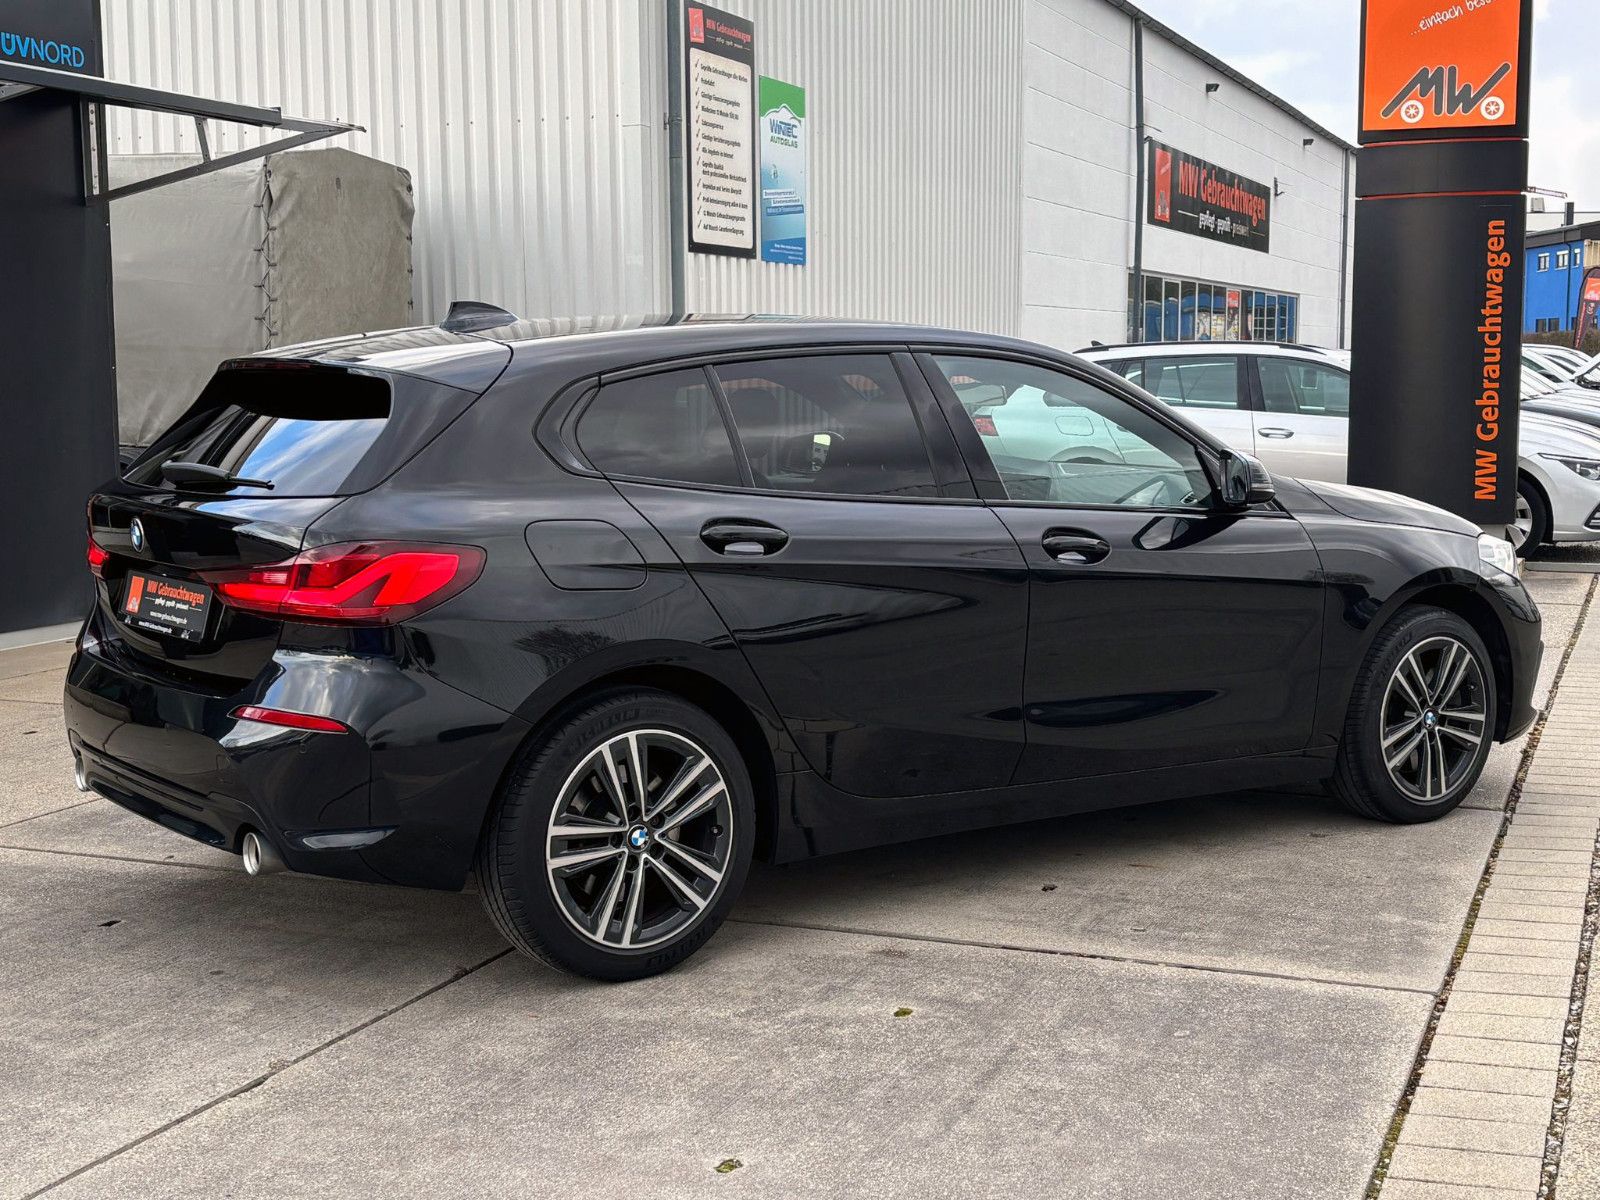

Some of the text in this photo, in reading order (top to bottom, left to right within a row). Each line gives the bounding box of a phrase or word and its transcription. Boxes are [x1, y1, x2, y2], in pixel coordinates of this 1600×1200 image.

[1179, 160, 1266, 227] MW Gebrauchtwagen
[1474, 219, 1511, 500] MW Gebrauchtwagen
[147, 580, 205, 607] MW Gebrauchtwagen
